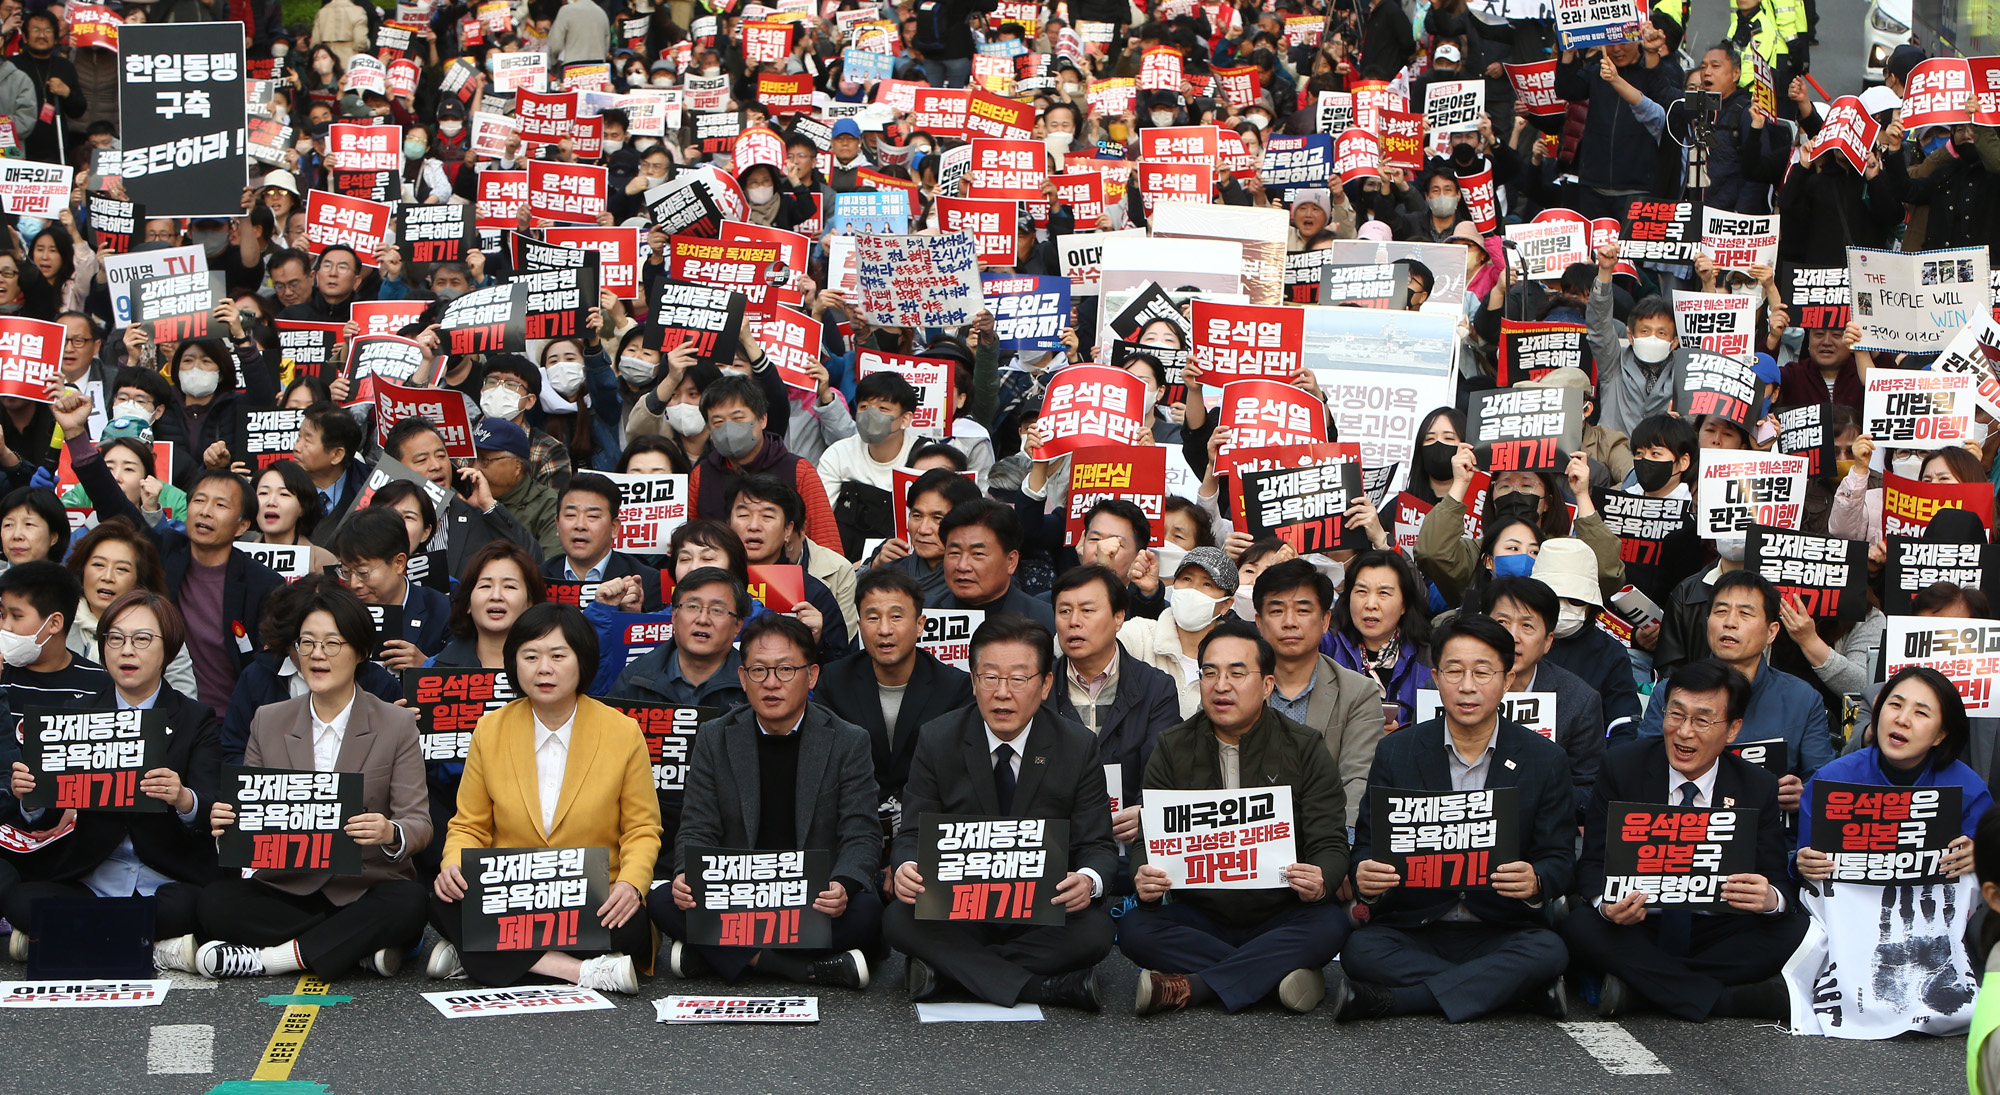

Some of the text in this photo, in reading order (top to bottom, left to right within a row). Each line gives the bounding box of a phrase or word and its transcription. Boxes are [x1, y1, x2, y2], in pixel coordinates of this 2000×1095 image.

[1561, 4, 1631, 25] 오라! 시민정치
[125, 52, 238, 84] 한일동맹
[501, 55, 541, 70] 매국외교
[1142, 53, 1181, 70] 윤석열
[508, 75, 534, 90] 파면!
[689, 78, 725, 90] 매국외교
[1141, 70, 1181, 91] 퇴진!
[1514, 71, 1556, 89] 윤석열
[1911, 70, 1966, 94] 윤석열
[155, 90, 211, 120] 구축
[521, 99, 567, 119] 윤석열
[694, 97, 720, 109] 파면!
[759, 94, 812, 105] 윤석열 퇴진
[924, 97, 966, 113] 윤석열
[1356, 90, 1403, 112] 윤석열
[1428, 92, 1477, 113] 친일야합
[515, 116, 575, 136] 정권심판!
[696, 112, 739, 126] 강제동원
[967, 115, 1005, 138] 윤석열
[1825, 105, 1867, 138] 윤석열
[340, 134, 388, 151] 윤석열
[735, 133, 783, 155] 윤석열
[1155, 137, 1205, 155] 윤석열
[1339, 137, 1378, 157] 윤석열
[1815, 122, 1867, 162] 정권심판!
[121, 140, 230, 179] 중단하라
[334, 152, 397, 169] 정권심판!
[981, 150, 1034, 169] 윤석열
[1263, 150, 1325, 170] 굴욕외교
[5, 167, 64, 183] 매국외교
[338, 172, 389, 189] 윤석열은
[541, 172, 595, 195] 윤석열
[972, 170, 1043, 190] 정권심판!
[1148, 173, 1197, 191] 윤석열
[1262, 166, 1331, 185] 심판하자!
[11, 196, 50, 213] 파면!
[90, 196, 134, 218] 강제동원
[405, 203, 463, 224] 강제동원
[531, 190, 604, 216] 정권심판!
[1627, 202, 1692, 223] 윤석열은
[90, 213, 134, 234] 굴욕해법
[319, 203, 374, 232] 윤석열
[947, 210, 999, 233] 윤석열
[1709, 217, 1770, 236] 매국외교
[308, 222, 381, 256] 정권심판!
[405, 221, 464, 241] 굴욕해법
[1631, 221, 1684, 241] 일본국
[1717, 235, 1777, 248] 김성한 김태효
[412, 240, 458, 262] 폐기!
[526, 244, 585, 267] 강제동원
[676, 242, 777, 262] 정치검찰 독재정권
[1524, 239, 1571, 256] 대법원
[109, 255, 196, 285] 이재명 TV
[683, 259, 757, 283] 윤석열을
[1713, 250, 1756, 270] 파면!
[140, 271, 210, 301] 강제동원
[1331, 264, 1395, 284] 강제동원
[1865, 273, 1887, 285] THE
[448, 283, 514, 313] 강제동원
[660, 284, 731, 310] 강제동원
[982, 278, 1033, 295] 윤석열정권
[1331, 280, 1395, 300] 굴욕해법
[1879, 288, 1963, 308] PEOPLE WILL
[141, 290, 212, 320] 굴욕해법
[441, 301, 513, 329] 굴욕해법
[924, 308, 968, 326] 수사하라
[1675, 298, 1749, 312] 사법주권 훼손말라!
[153, 312, 208, 344] 폐기!
[657, 305, 729, 331] 굴욕해법
[1684, 313, 1736, 333] 대법원
[1930, 311, 1968, 328] WIN
[0, 332, 43, 352] 석열
[450, 323, 505, 354] 폐기!
[1208, 318, 1282, 347] 윤석열
[1518, 332, 1581, 352] 강제동원
[1681, 334, 1749, 355] 판결이행!
[360, 342, 424, 365] 강제동원
[1196, 344, 1297, 377] 정권심판!
[1519, 350, 1581, 369] 굴욕해법
[1685, 353, 1757, 387] 강제동원
[1683, 371, 1756, 406] 굴욕해법
[1868, 376, 1968, 392] 사법주권 훼손말라!
[1050, 380, 1128, 413] 윤석열
[1480, 388, 1565, 416] 강제동원
[1688, 391, 1749, 424] 폐기!
[1885, 392, 1955, 415] 대법원
[1235, 396, 1312, 432] 윤석열
[1778, 403, 1821, 432] 강제동원
[1036, 413, 1138, 445] 정권심판!
[1479, 414, 1564, 441] 굴욕해법
[1780, 425, 1823, 454] 굴욕해법
[1869, 415, 1968, 441] 판결이행!
[1489, 438, 1556, 472] 폐기!
[1704, 458, 1803, 479] 사법주권 훼손말라!
[1256, 464, 1342, 502] 강제동원
[1725, 477, 1792, 504] 대법원
[645, 503, 685, 520] 김태효
[1261, 489, 1347, 528] 굴욕해법
[1603, 494, 1684, 520] 강제동원
[1709, 504, 1799, 533] 판결이행!
[1759, 533, 1849, 563] 강제동원
[1899, 543, 1981, 568] 강제동원
[1759, 559, 1849, 587] 굴욕해법
[40, 709, 142, 741] 강제동원
[41, 740, 145, 771] 굴욕해법
[55, 770, 136, 809] 폐기!
[237, 773, 339, 802] 강제동원
[1163, 792, 1275, 833] 매국외교
[1388, 789, 1494, 823] 강제동원
[1825, 790, 1940, 820] 윤석열은
[238, 803, 342, 832] 굴욕해법
[1621, 811, 1737, 842] 윤석열은
[937, 819, 1046, 851] 강제동원
[1149, 821, 1291, 857] 박진 김성한 김태효
[1390, 819, 1497, 853] 굴욕해법
[1842, 821, 1926, 850] 일본국
[250, 833, 332, 869] 폐기!
[1636, 844, 1722, 873] 일본국
[479, 847, 585, 884] 강제동원
[701, 851, 804, 881] 강제동원
[937, 849, 1045, 882] 굴욕해법
[1184, 849, 1257, 885] 파면!
[1405, 850, 1489, 888] 폐기!
[481, 878, 588, 914] 굴욕해법
[704, 879, 808, 910] 굴욕해법
[949, 881, 1033, 920] 폐기!
[496, 909, 578, 951] 폐기!
[719, 909, 799, 946] 폐기!
[13, 984, 153, 995] 이대로는
